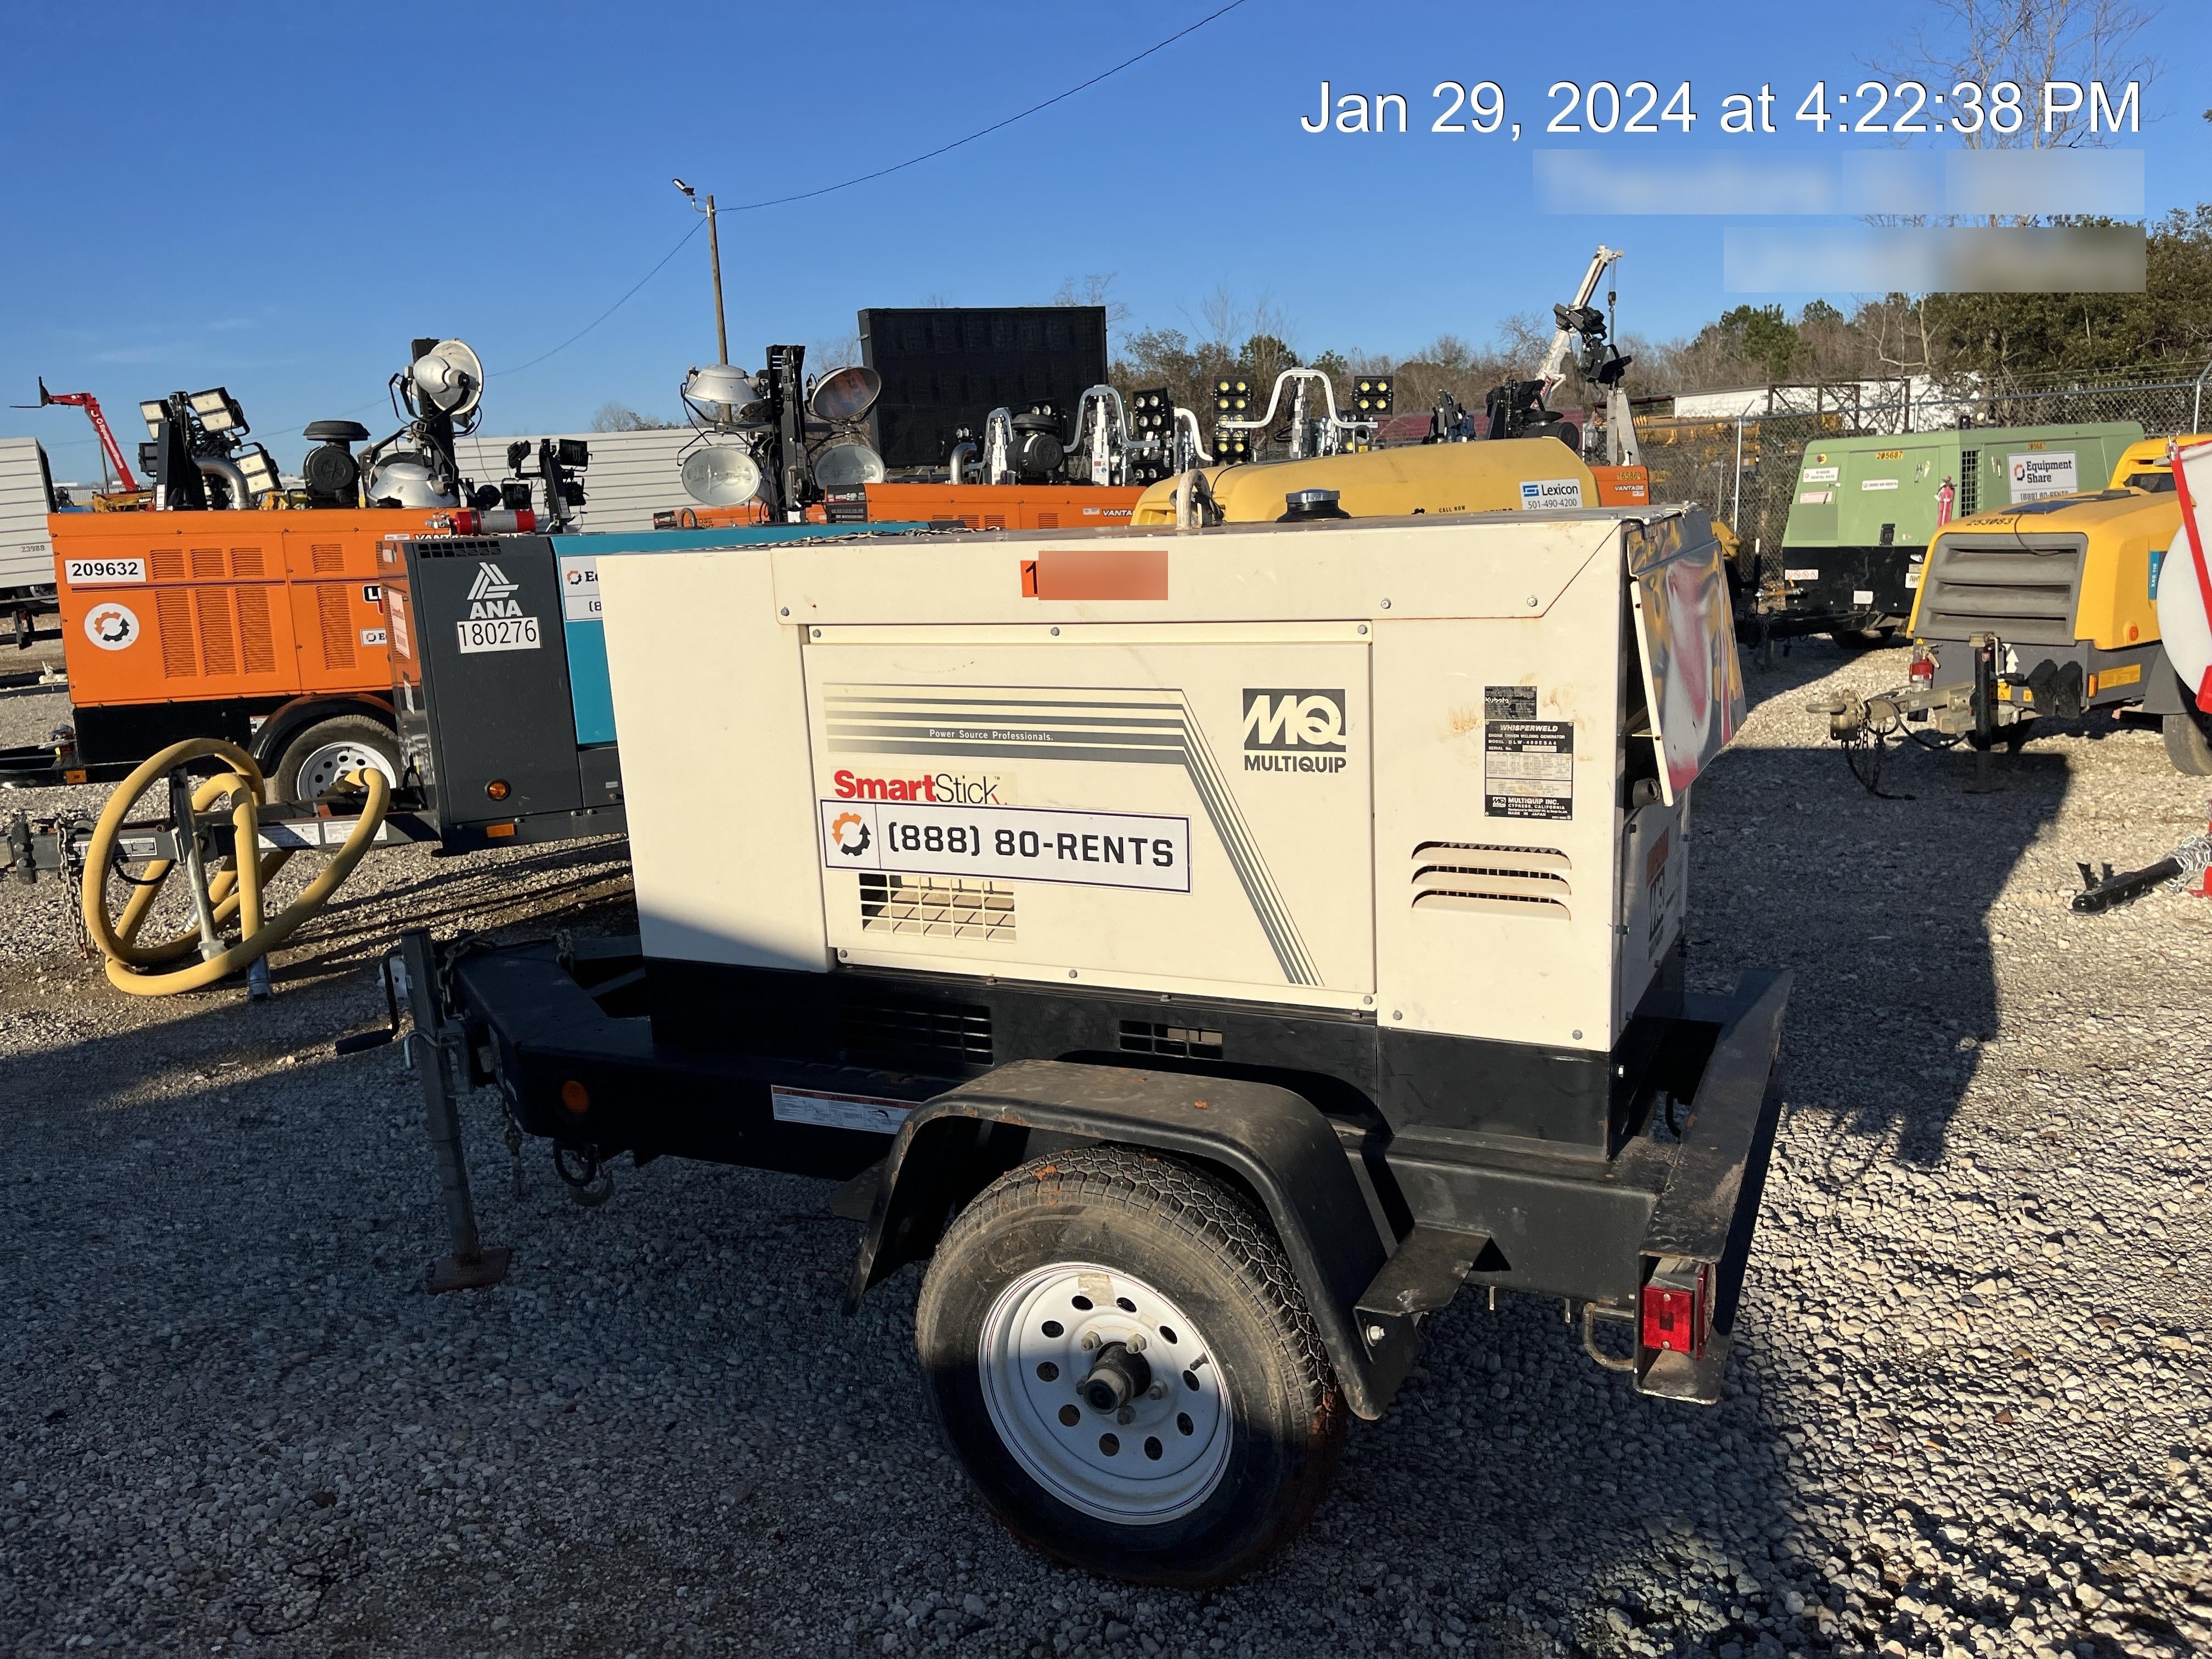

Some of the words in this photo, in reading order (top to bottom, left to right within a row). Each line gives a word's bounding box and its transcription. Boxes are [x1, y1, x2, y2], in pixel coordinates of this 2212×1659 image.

[1877, 450, 1903, 460] 205687
[2026, 460, 2072, 473] Equipment
[1617, 472, 1641, 480] 165869
[2027, 473, 2052, 483] Share
[1541, 484, 1578, 496] Lexicon
[1528, 499, 1577, 509] 501-490-4200
[71, 562, 138, 577] 209632
[1025, 561, 1038, 595] 1
[470, 600, 523, 619] ANA
[459, 620, 537, 647] 180276
[1243, 695, 1346, 746] MQ
[929, 729, 955, 737] Power
[959, 730, 988, 739] Source
[992, 731, 1054, 741] Professionals.
[1244, 755, 1346, 773] MULTIQUIP
[834, 770, 998, 804] SmartStick
[888, 821, 980, 856] (888)
[995, 829, 1173, 867] 80-RENTS
